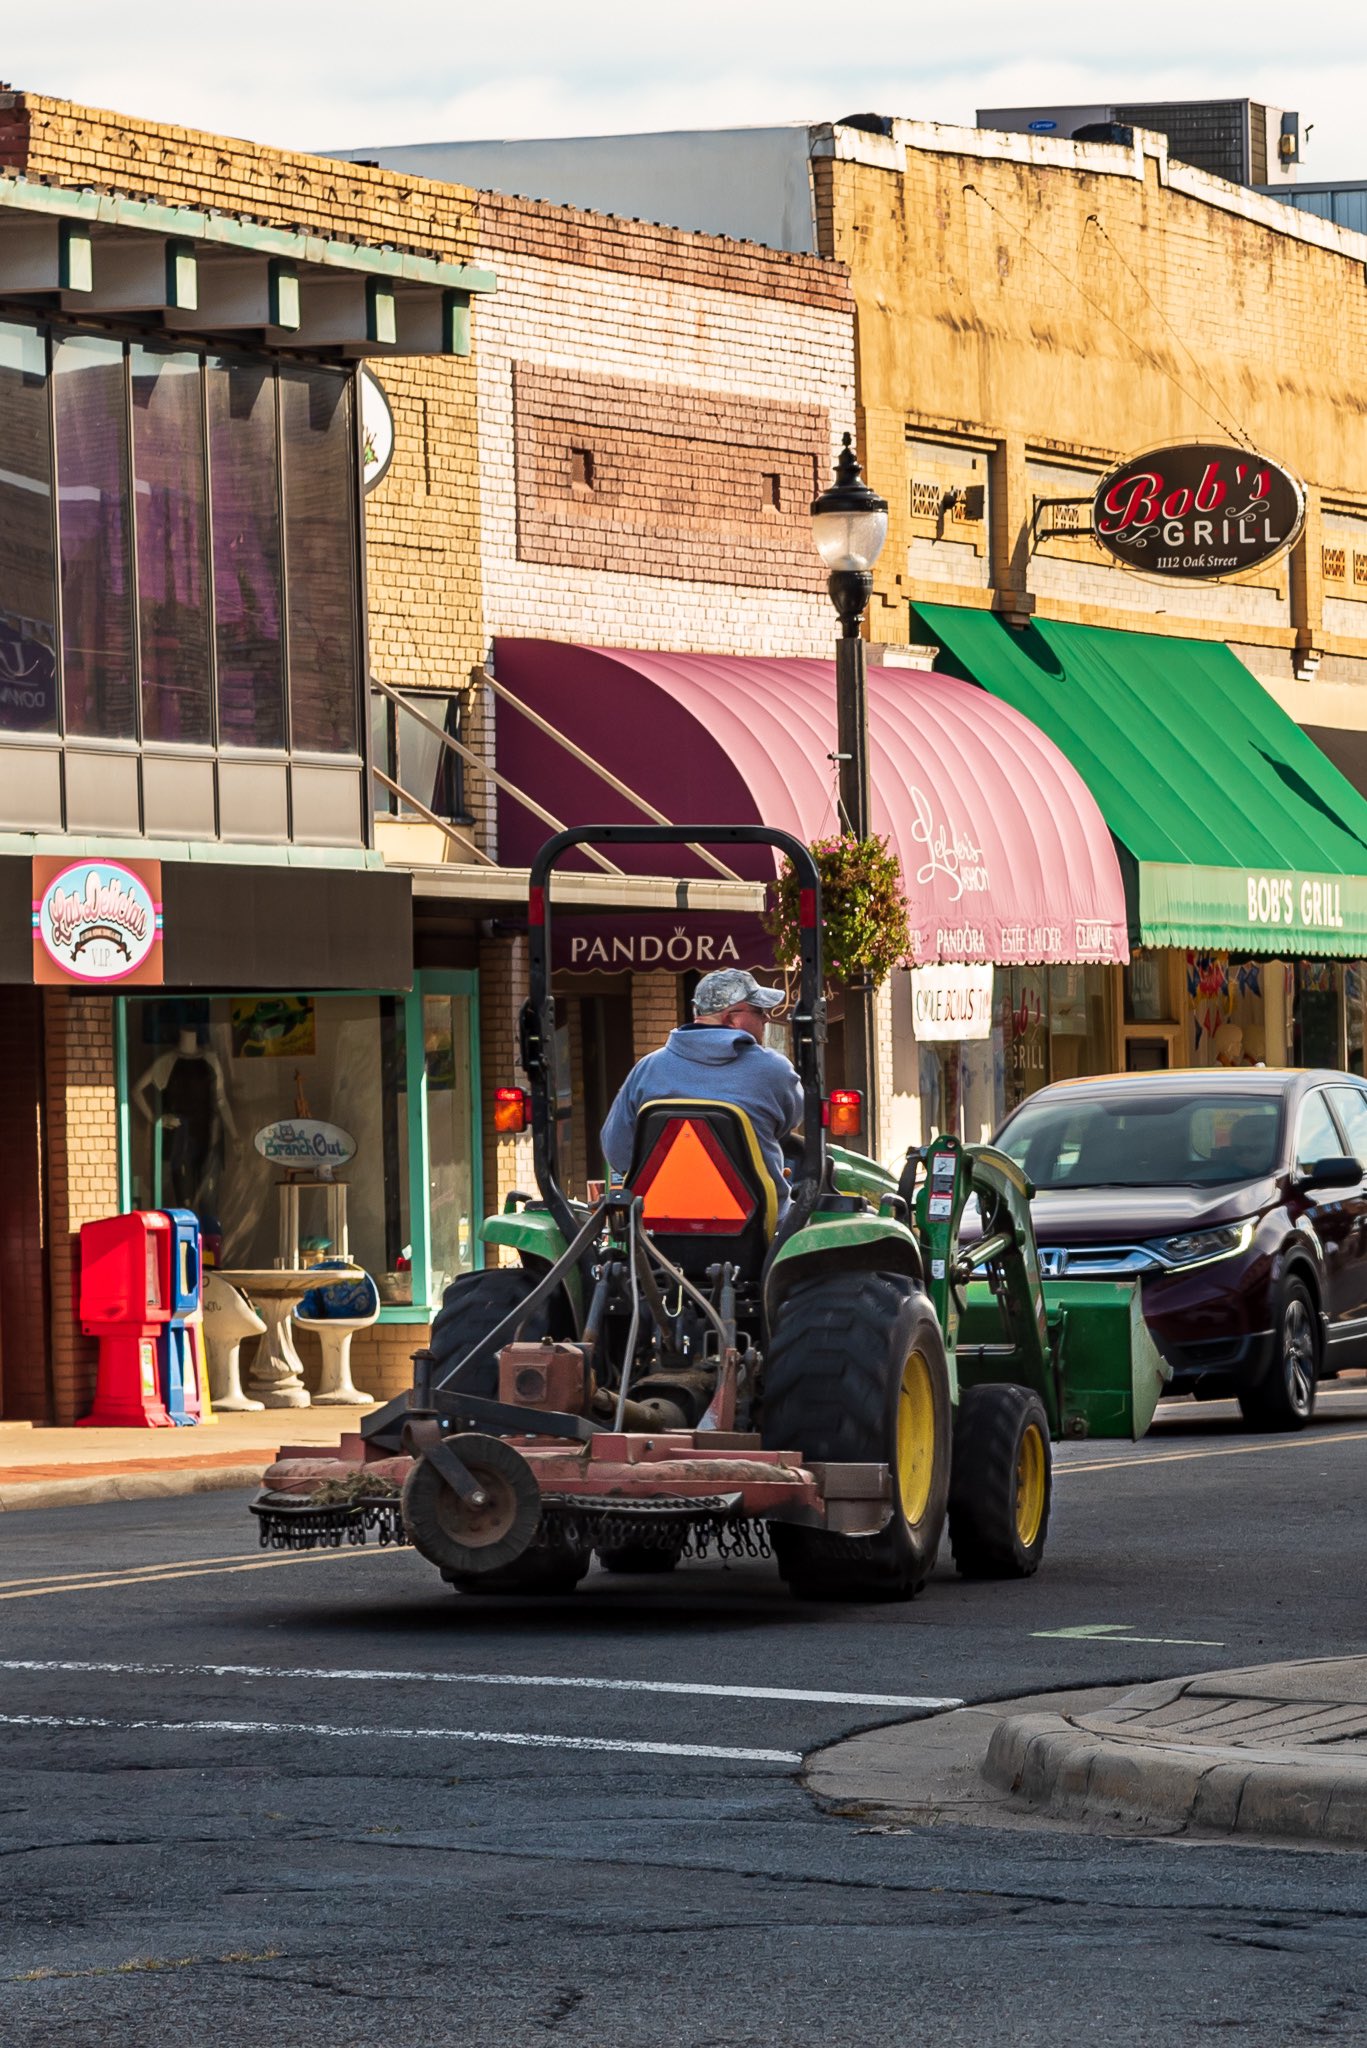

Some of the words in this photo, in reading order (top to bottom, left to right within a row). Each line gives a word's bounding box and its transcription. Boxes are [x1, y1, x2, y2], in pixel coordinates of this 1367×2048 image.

[1099, 461, 1272, 535] Bob's
[1163, 519, 1281, 546] GRILL
[1156, 556, 1180, 569] 1112
[1183, 555, 1205, 568] Oak
[1207, 555, 1238, 567] Street
[1247, 877, 1293, 925] BOB'S
[1300, 880, 1344, 928] GRILL
[570, 934, 741, 962] PANDORA
[936, 925, 986, 953] PANDORA
[265, 1139, 315, 1156] Branch
[313, 1133, 343, 1156] Out
